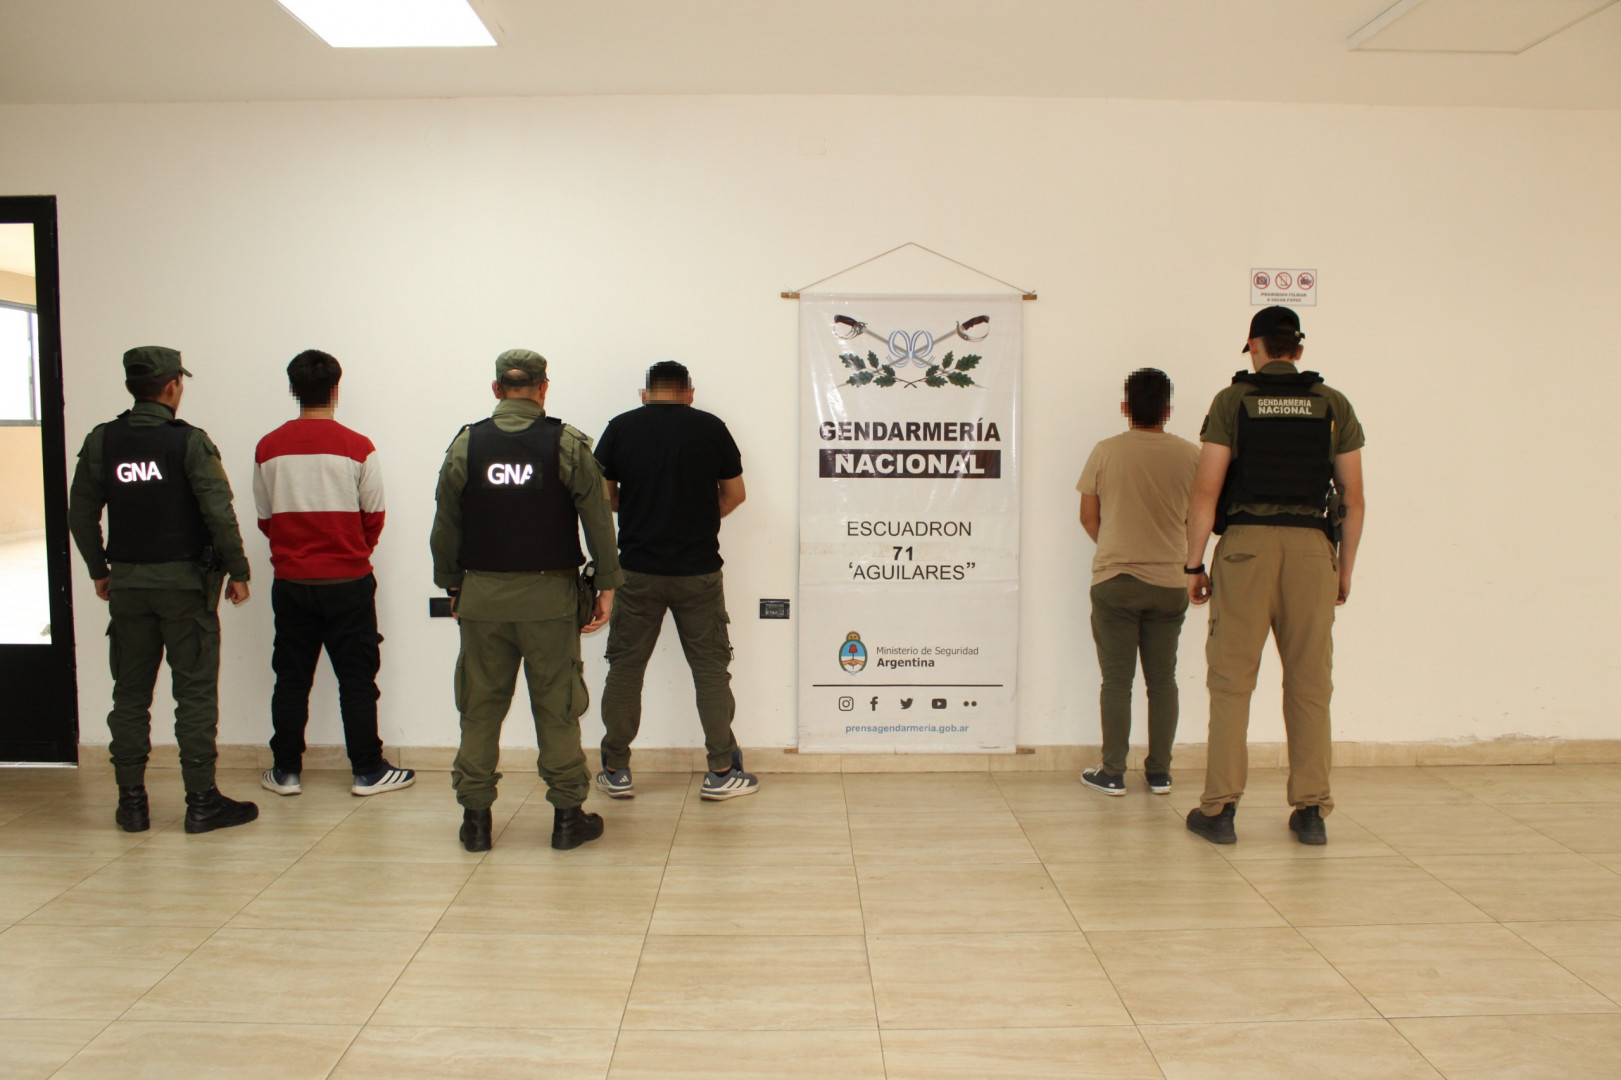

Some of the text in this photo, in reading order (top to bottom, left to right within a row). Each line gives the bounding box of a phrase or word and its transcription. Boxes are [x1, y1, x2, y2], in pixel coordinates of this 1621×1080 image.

[1258, 406, 1313, 415] NACIONAL
[819, 418, 1001, 442] GENDARMERÍA
[835, 453, 985, 475] NACIONAL
[116, 461, 163, 483] GNA
[847, 520, 972, 537] ESCUADRON
[893, 546, 914, 561] 71
[876, 646, 979, 658] Ministerio de Seguridad
[877, 657, 935, 669] Argentina
[845, 723, 969, 734] prensagendarmeria.gob.ar
